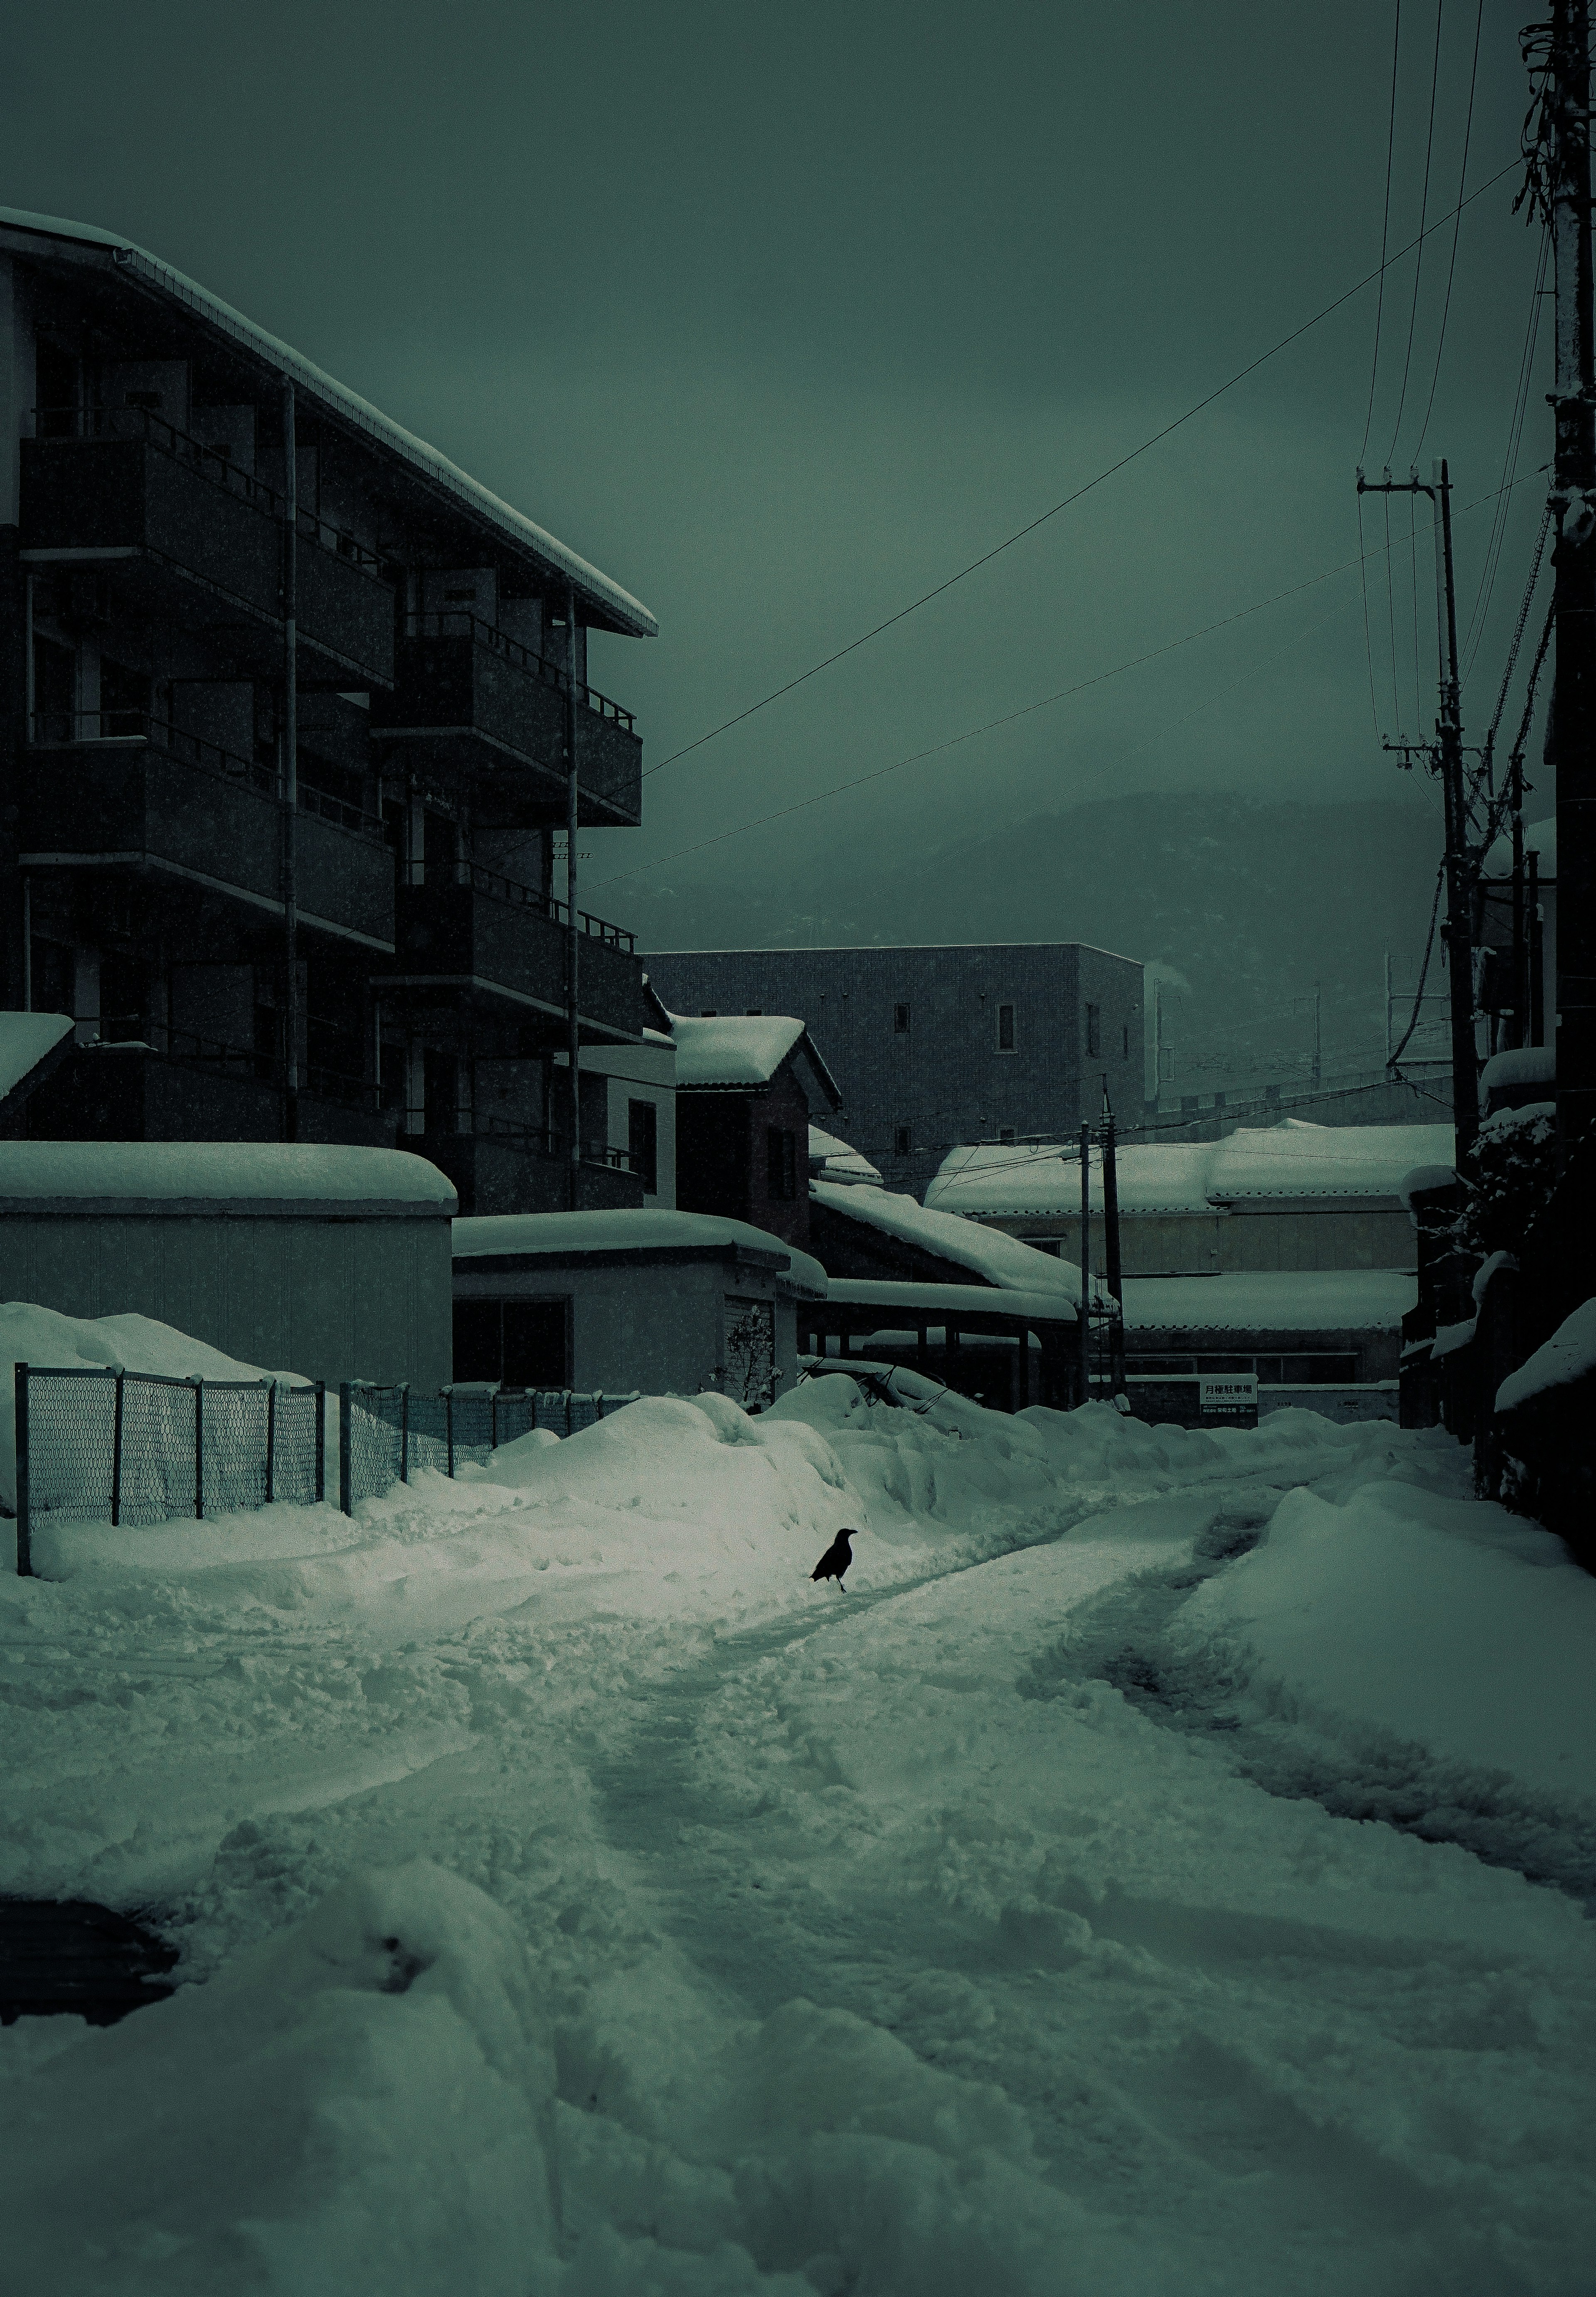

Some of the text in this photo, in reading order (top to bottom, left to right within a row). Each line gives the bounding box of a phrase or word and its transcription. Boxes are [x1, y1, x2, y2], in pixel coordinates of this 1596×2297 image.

[1206, 1385, 1252, 1394] 月極駐車場
